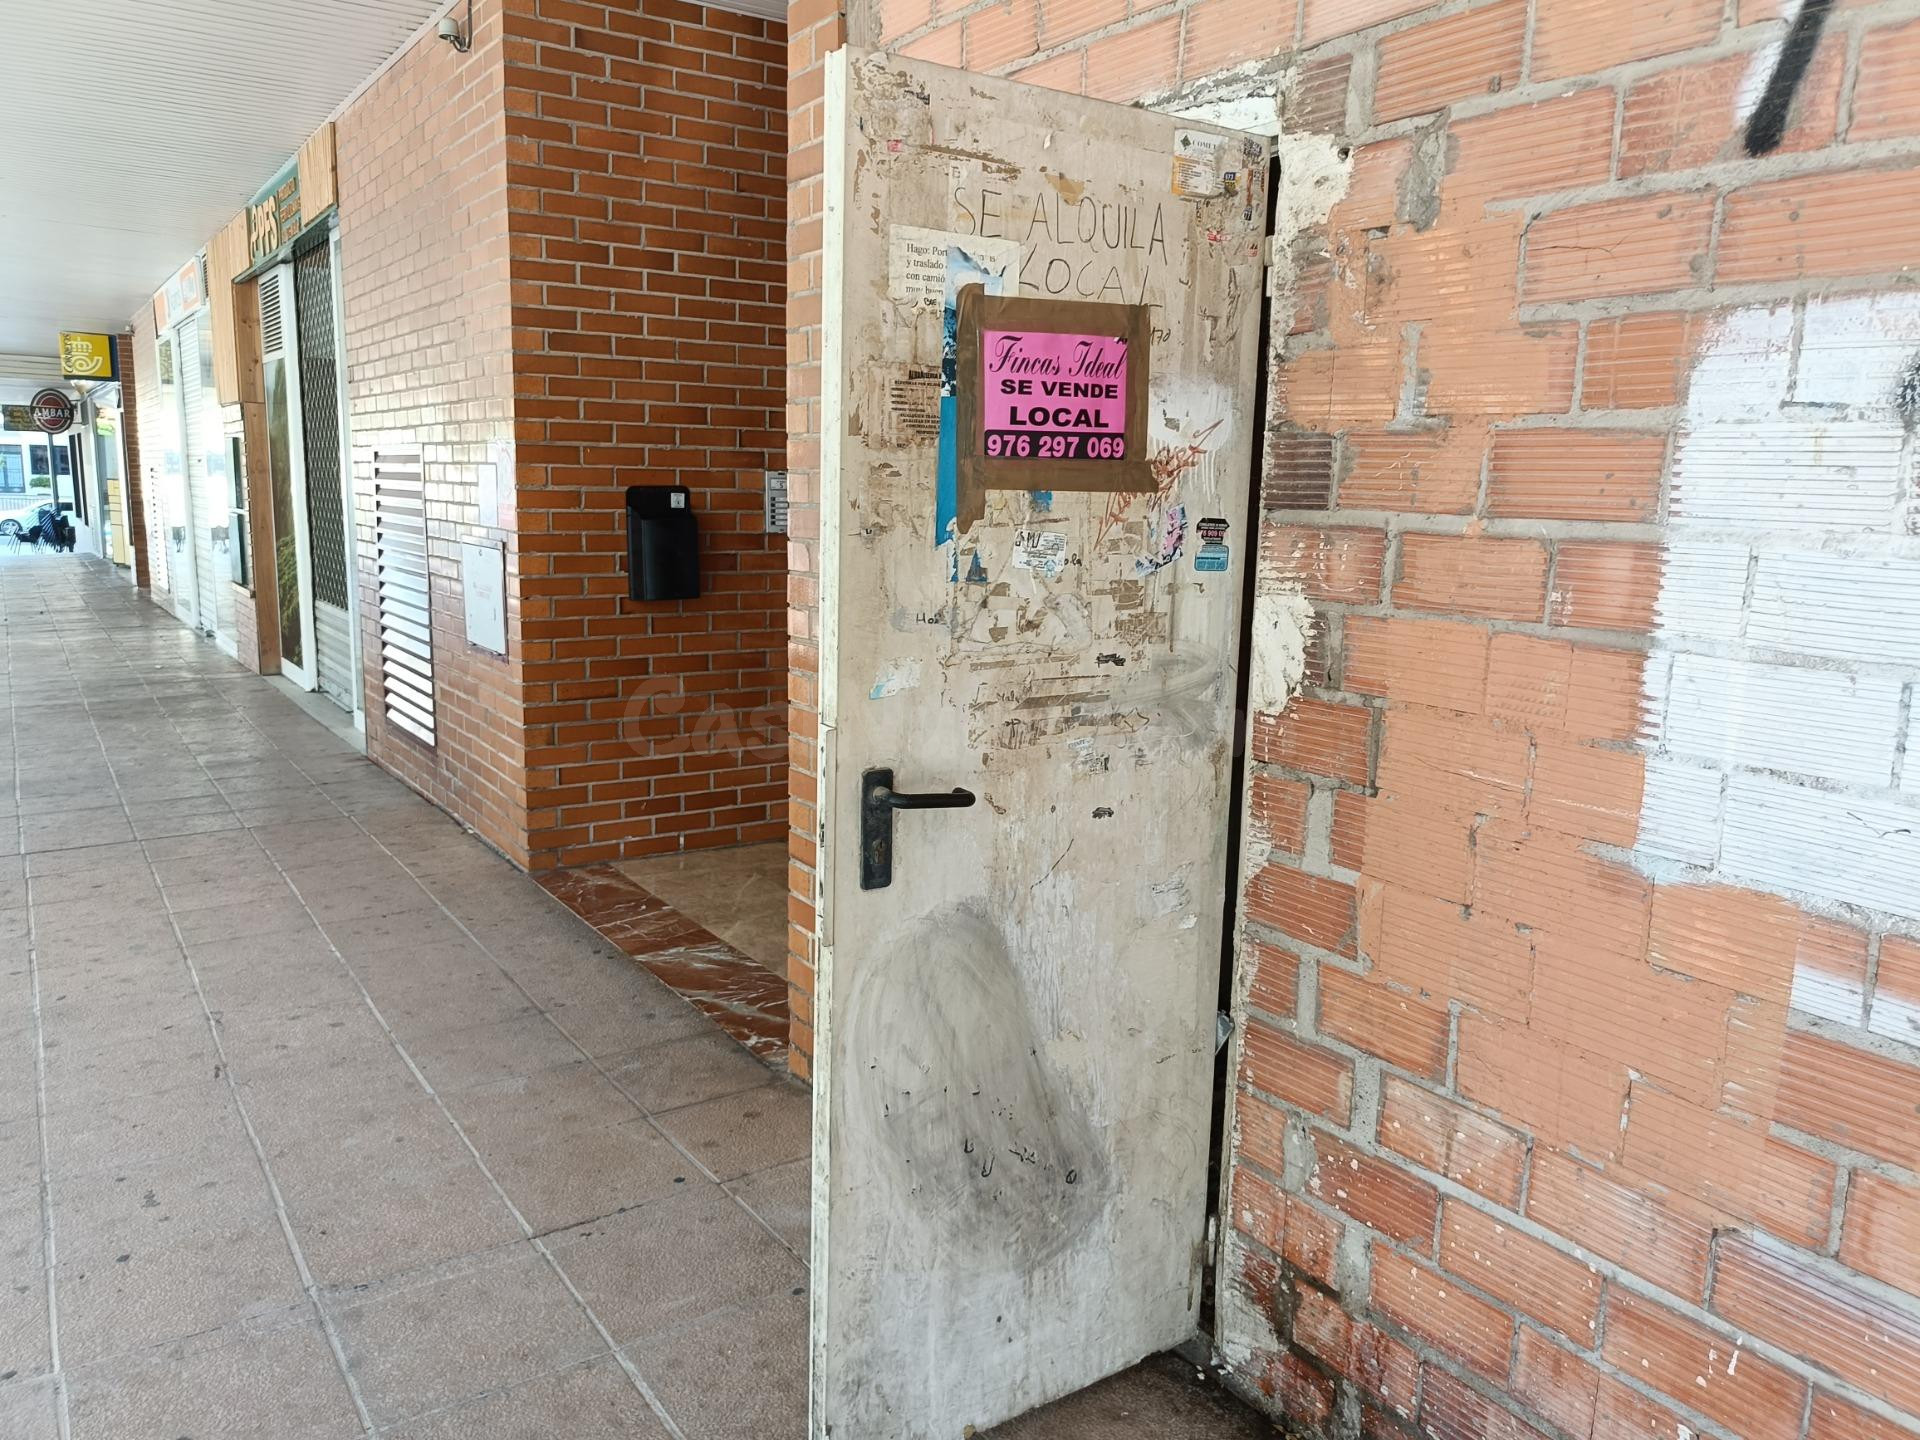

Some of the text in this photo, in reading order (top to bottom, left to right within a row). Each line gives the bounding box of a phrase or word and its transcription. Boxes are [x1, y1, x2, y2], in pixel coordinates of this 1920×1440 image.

[954, 186, 1168, 266] SE ALQUILA
[906, 243, 930, 257] Hago:
[906, 259, 911, 269] y
[906, 272, 920, 280] con
[1018, 242, 1164, 308] LOCAL
[989, 335, 1128, 380] Fincas Ideal
[1000, 379, 1119, 399] SE VENDE
[34, 406, 71, 419] AMBAR
[1009, 406, 1110, 429] LOCAL
[987, 434, 1125, 459] 976 297 069
